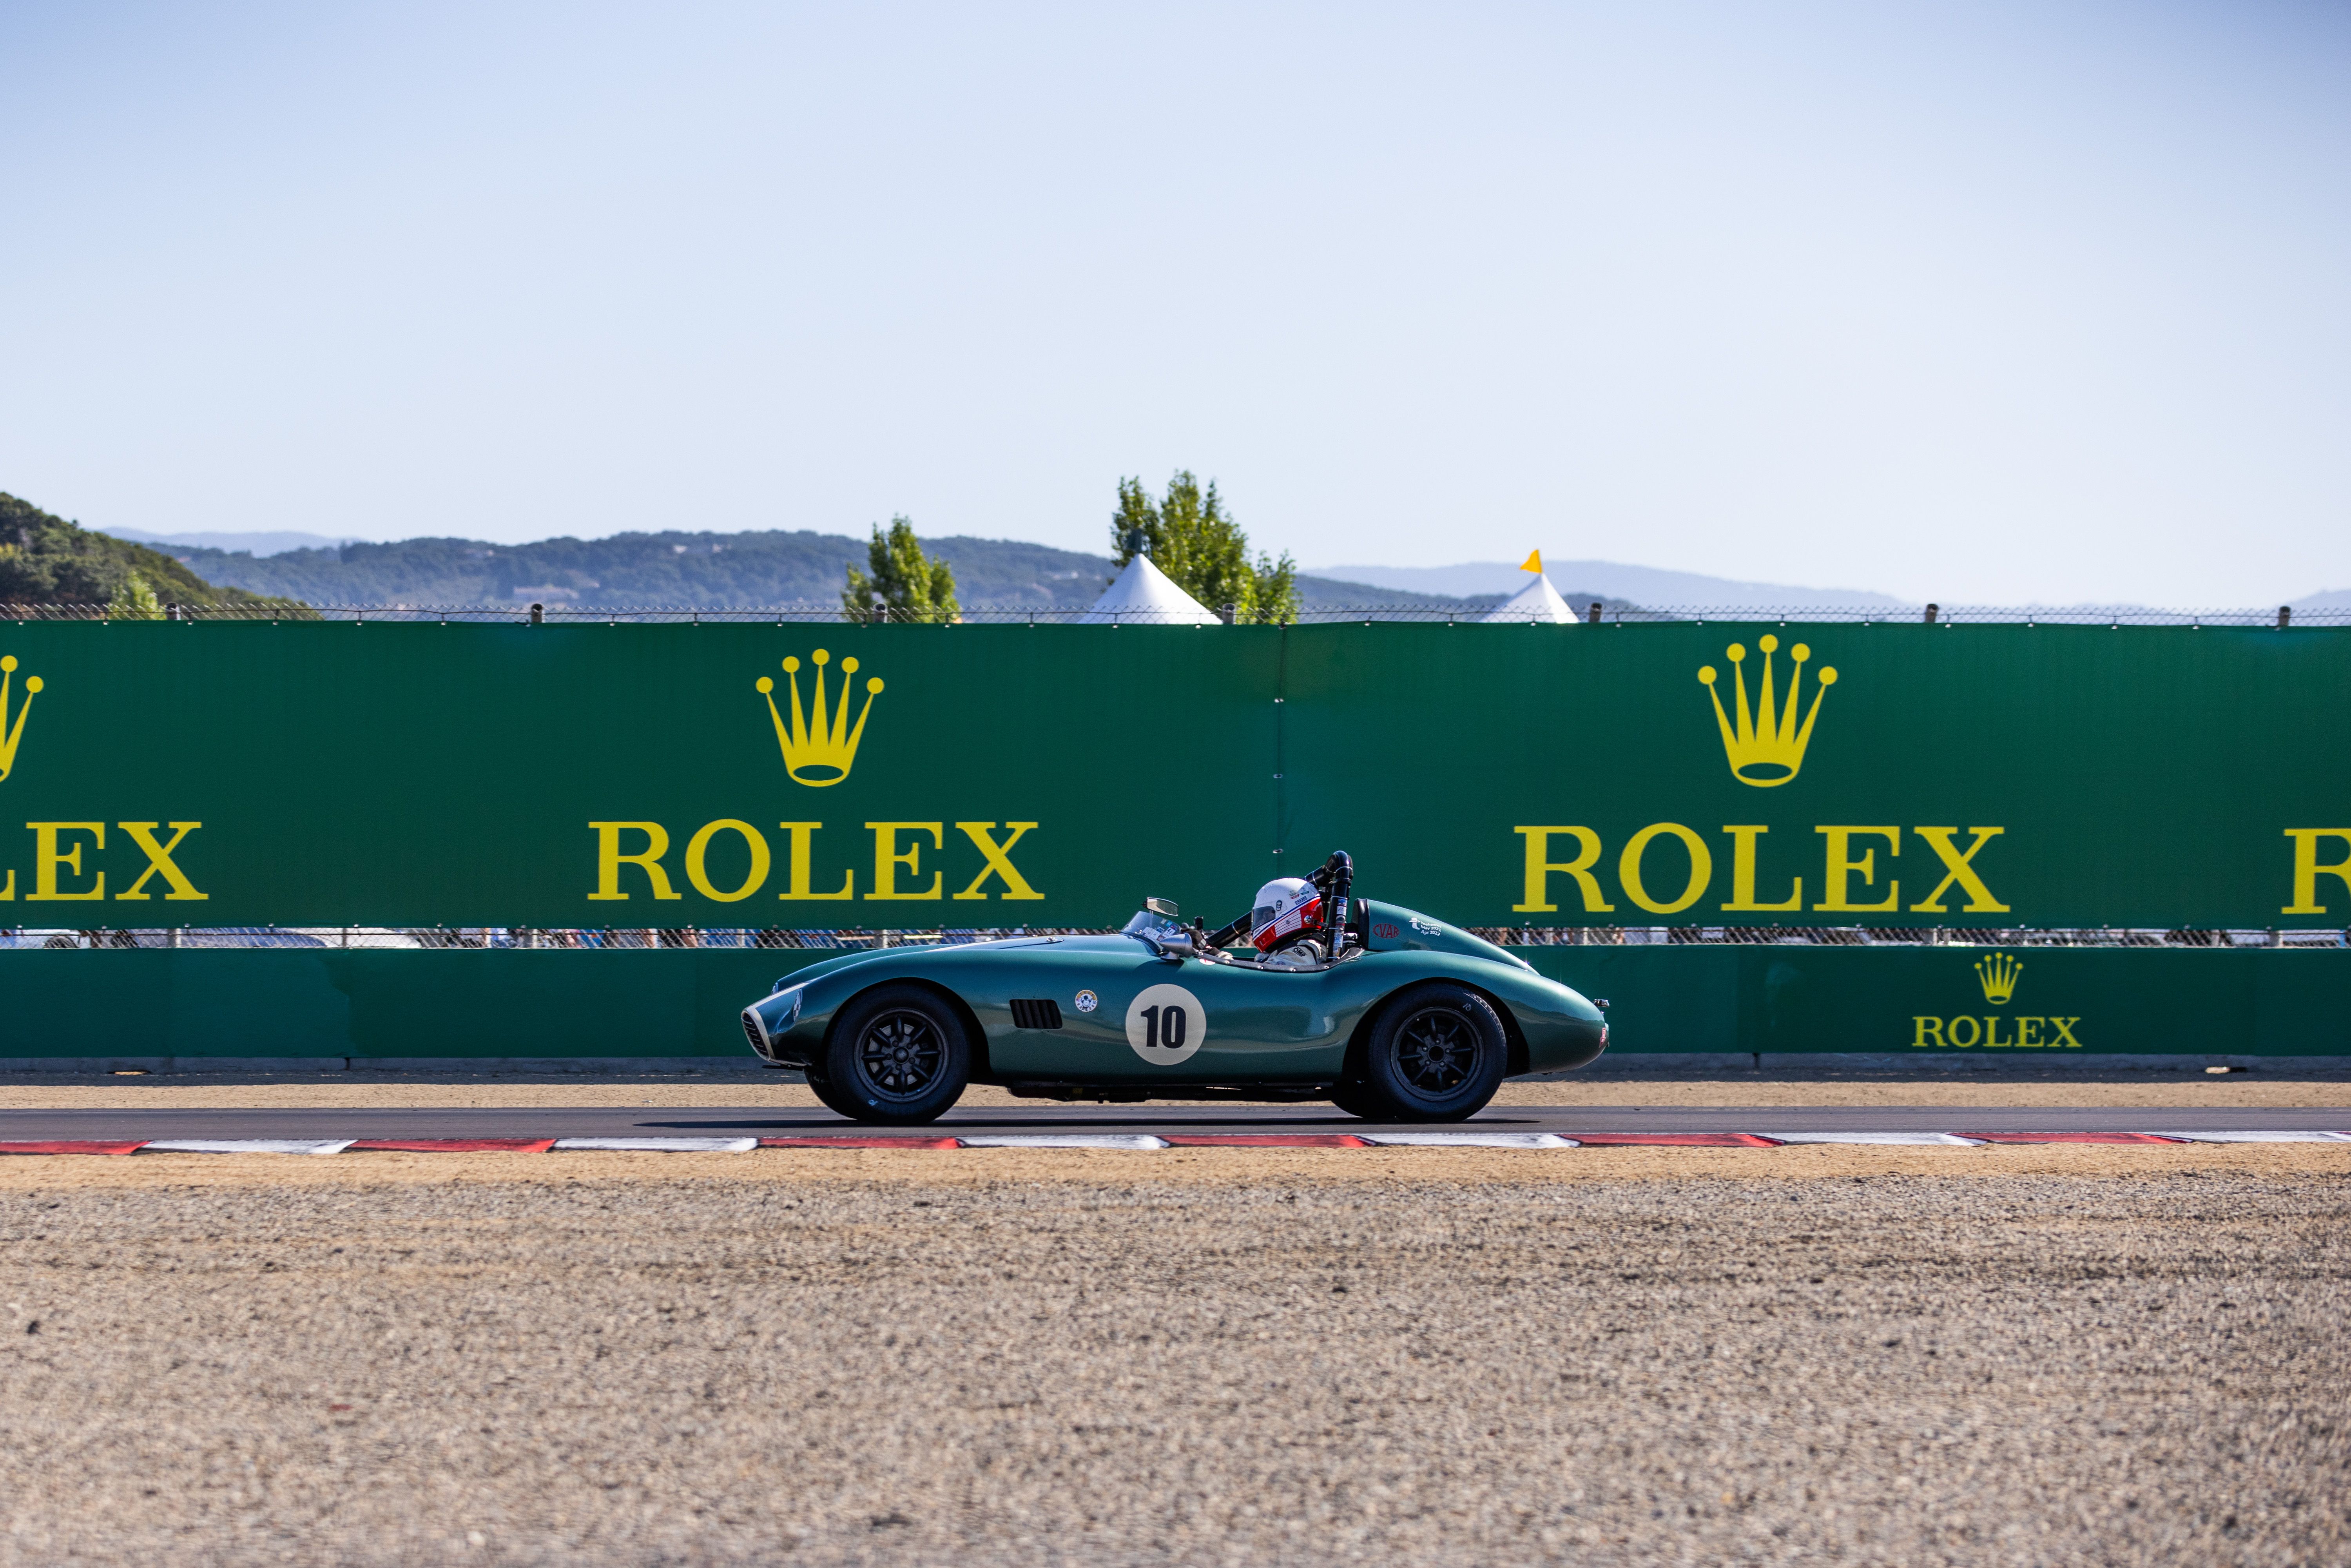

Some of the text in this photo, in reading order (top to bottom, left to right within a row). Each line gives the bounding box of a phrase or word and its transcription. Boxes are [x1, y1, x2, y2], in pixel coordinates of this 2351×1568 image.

[0, 822, 209, 901] EX
[587, 818, 1045, 903] ROLEX
[1512, 822, 2010, 914] ROLEX
[1293, 947, 1305, 957] OMP
[1374, 924, 1399, 938] CVAR
[1140, 1005, 1186, 1049] 10
[1912, 1015, 2083, 1048] ROLEX
